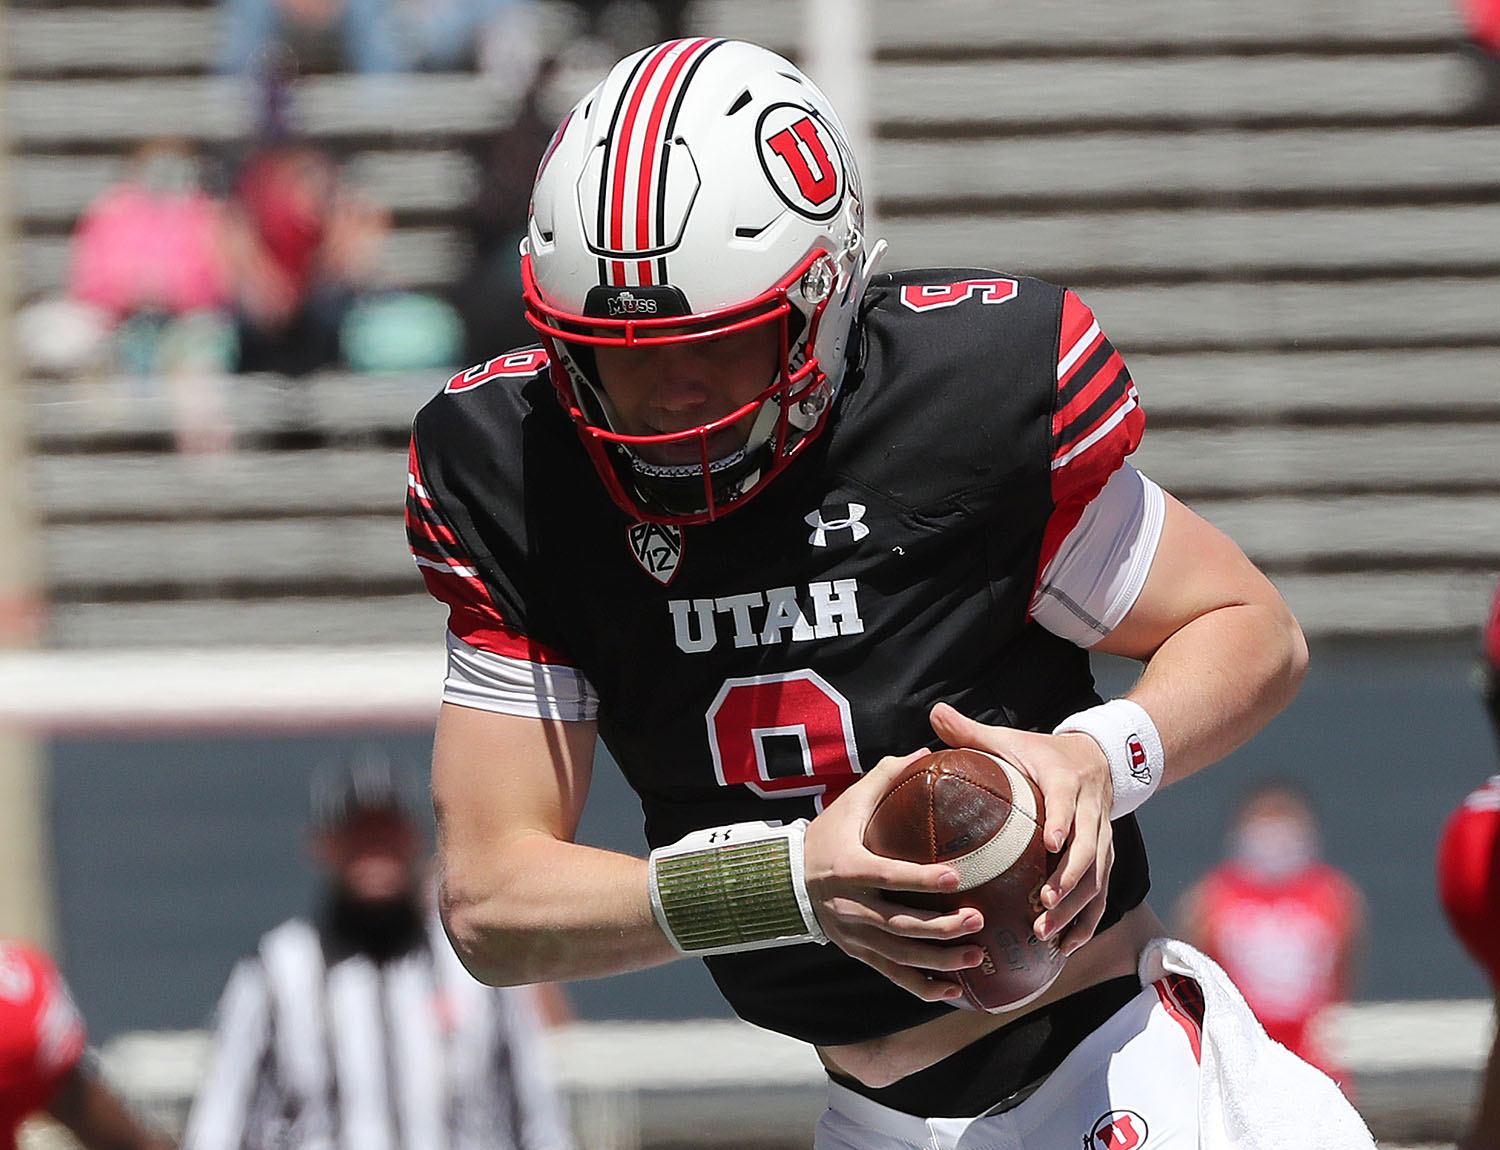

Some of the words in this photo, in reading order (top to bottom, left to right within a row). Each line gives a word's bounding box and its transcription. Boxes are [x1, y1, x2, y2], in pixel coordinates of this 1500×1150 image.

[765, 116, 837, 207] U
[608, 298, 658, 316] MUSS
[900, 278, 1018, 312] 9
[668, 578, 864, 653] UTAH
[705, 668, 864, 816] 9
